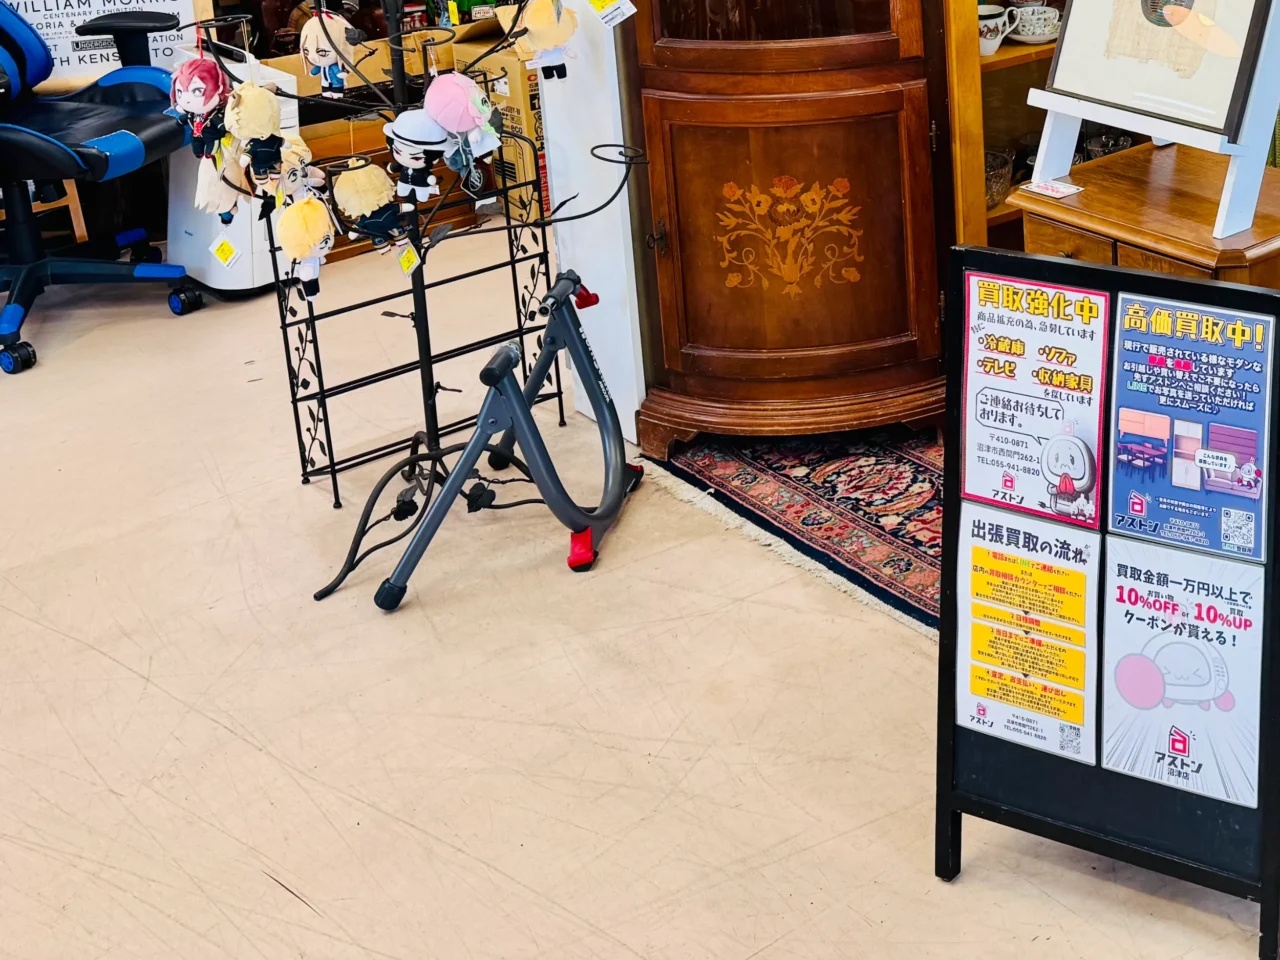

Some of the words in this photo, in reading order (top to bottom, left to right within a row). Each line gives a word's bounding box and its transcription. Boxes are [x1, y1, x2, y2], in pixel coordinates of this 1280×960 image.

[43, 10, 93, 20] CENTENARY
[148, 33, 184, 44] ATION
[511, 125, 523, 134] eco
[977, 280, 1098, 325] 買取強化中
[977, 311, 1096, 341] 商品拡充の為、急募しています
[1123, 302, 1265, 352] 高価買取中！
[979, 393, 1061, 420] ご連絡お待ちして
[1043, 388, 1093, 406] を探しています
[979, 408, 1022, 428] おります。
[992, 489, 1024, 505] アストン
[1115, 512, 1159, 534] アストン
[971, 519, 1088, 565] 出張買取の流れ
[1116, 563, 1253, 605] 買取金額一万円以上で
[1147, 590, 1175, 602] お買い物
[1115, 585, 1180, 616] 10%OFF
[1181, 610, 1190, 619] or
[1193, 602, 1253, 631] 10%UP
[1229, 607, 1244, 617] 買取
[1124, 609, 1238, 647] クーポンが貰える！
[969, 715, 994, 728] アストン
[1154, 751, 1203, 774] アストン
[1167, 767, 1190, 781] 沼津店
